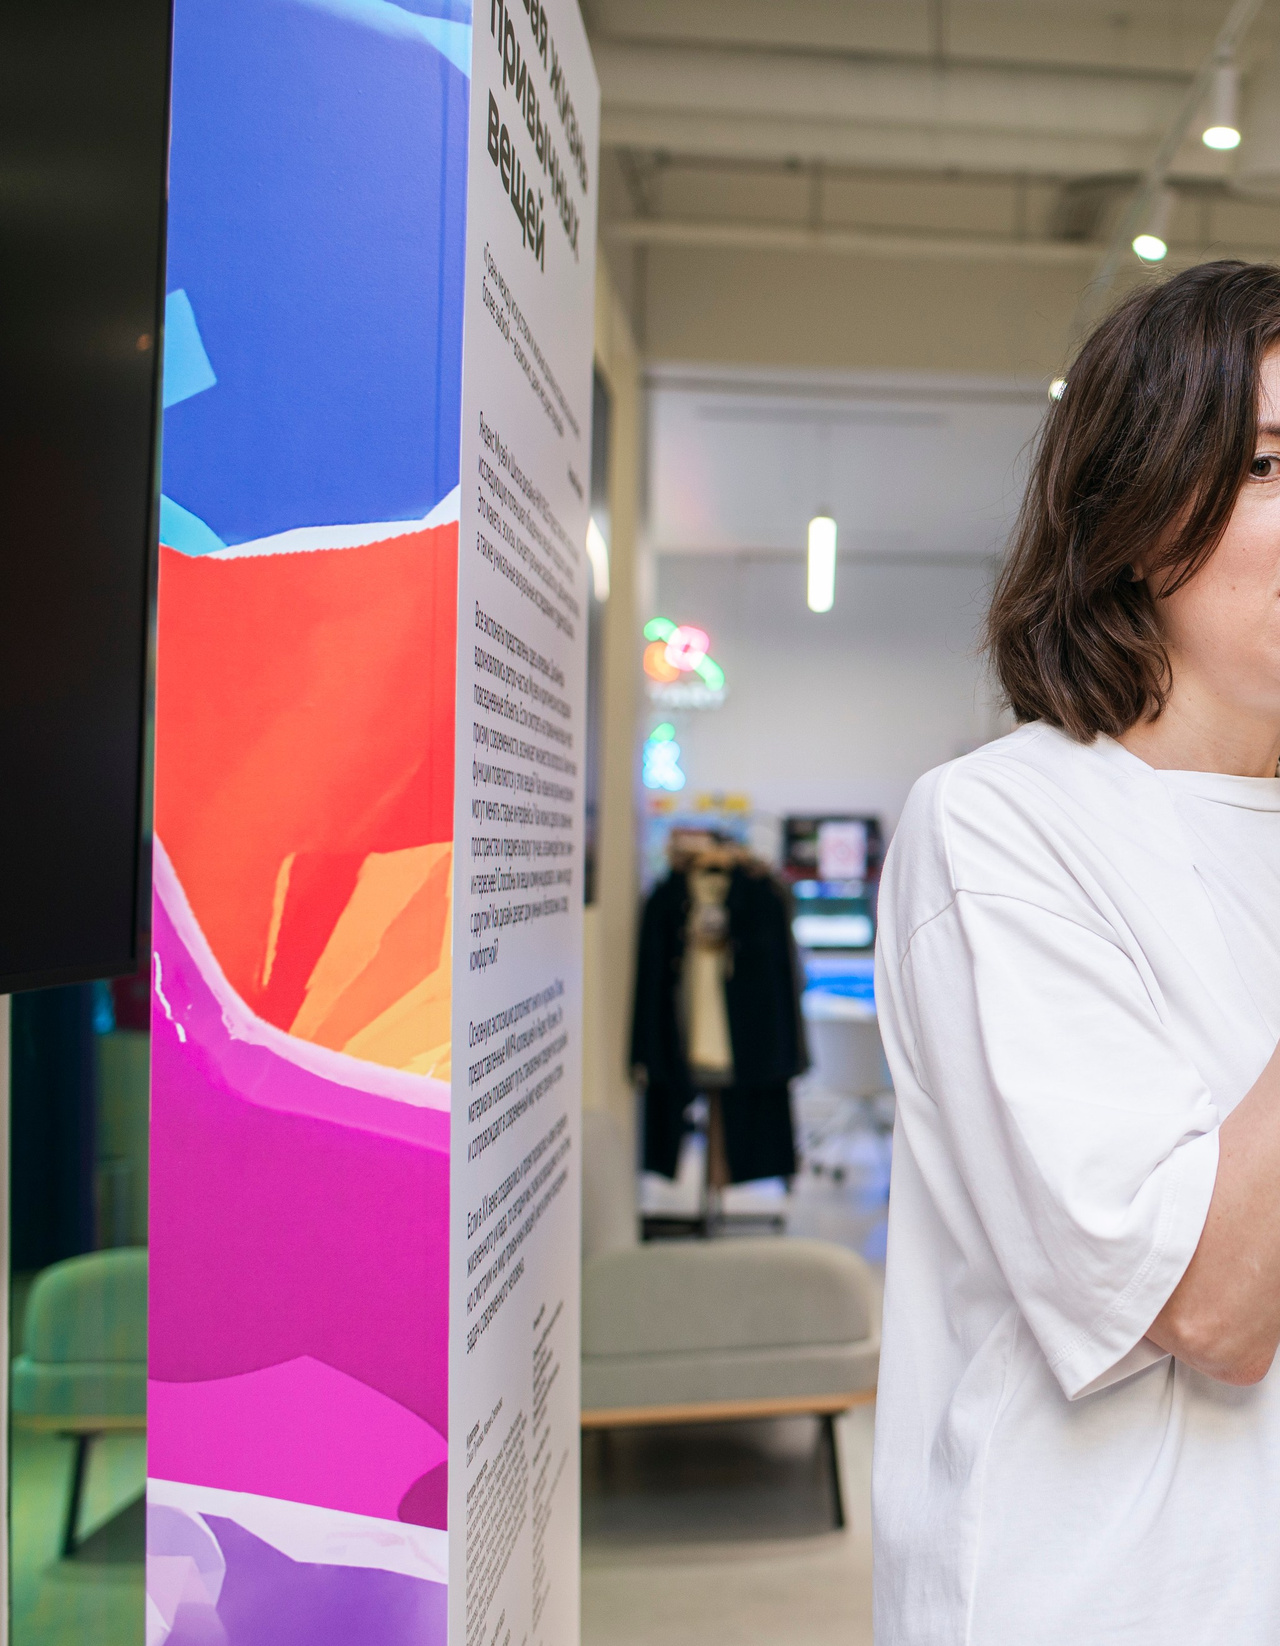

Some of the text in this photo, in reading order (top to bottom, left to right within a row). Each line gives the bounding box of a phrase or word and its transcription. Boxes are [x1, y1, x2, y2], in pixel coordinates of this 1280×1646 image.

[487, 87, 546, 274] вещей
[490, 0, 580, 263] привычных
[522, 0, 588, 195] ая жизнь
